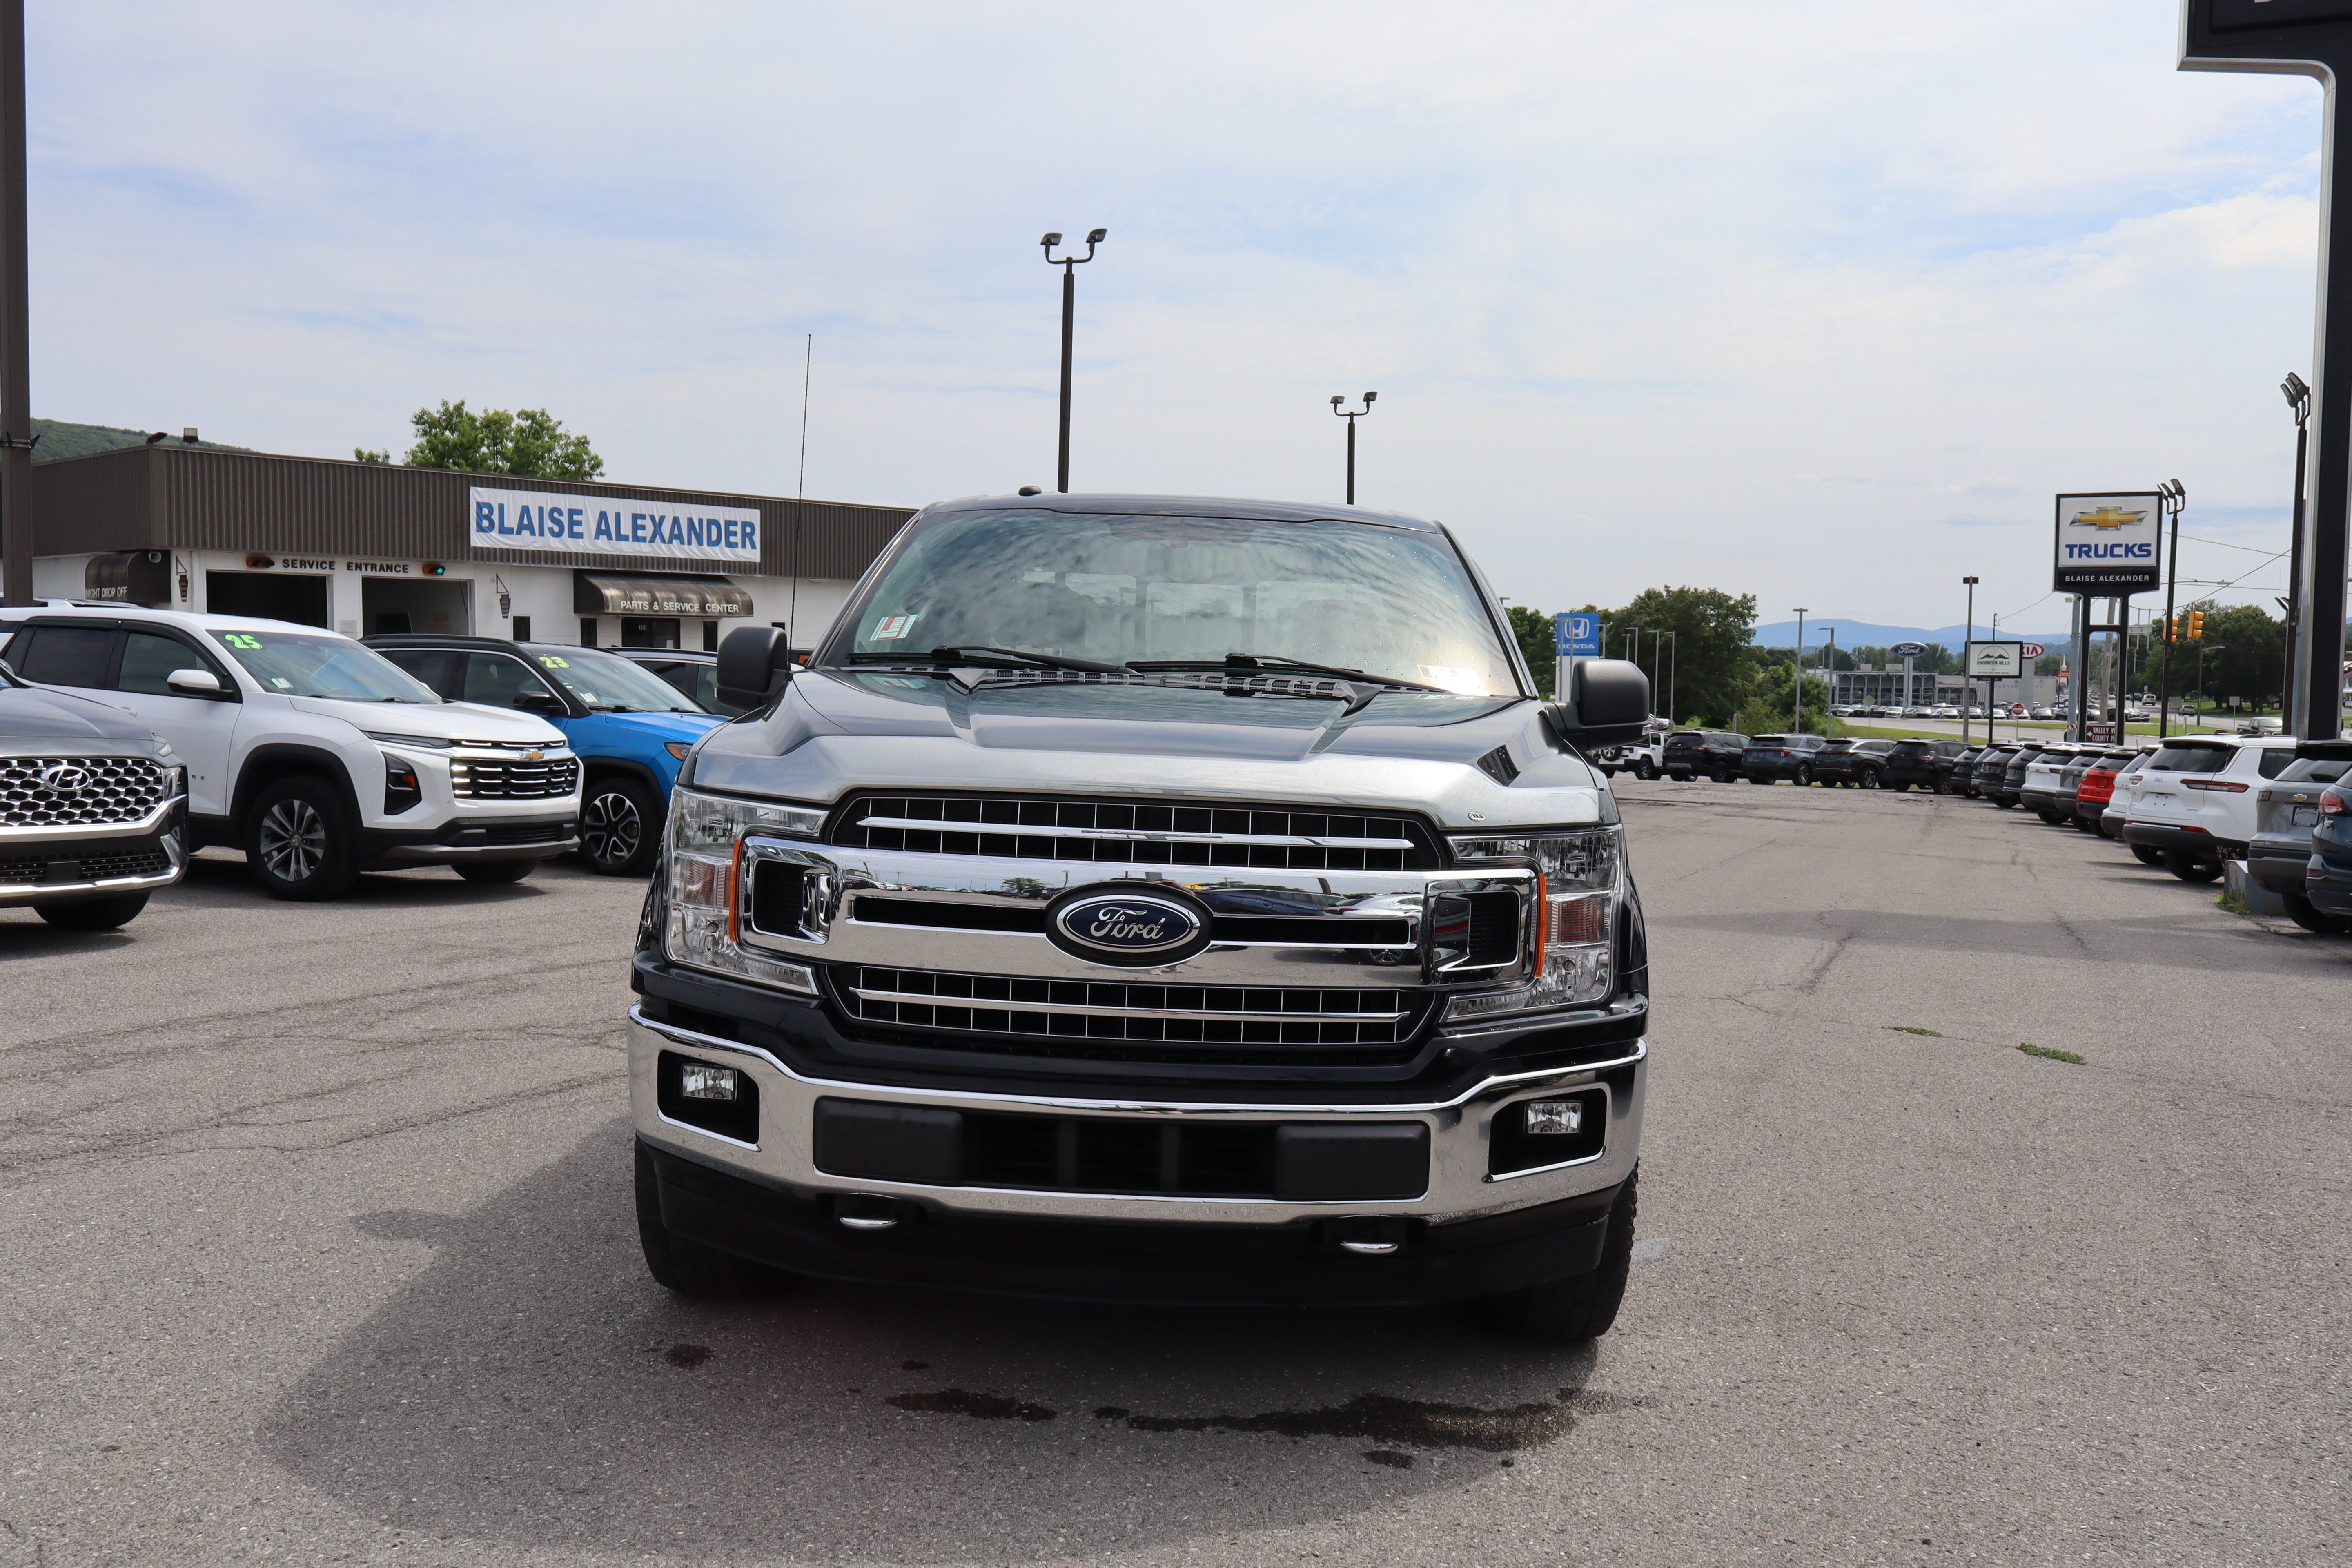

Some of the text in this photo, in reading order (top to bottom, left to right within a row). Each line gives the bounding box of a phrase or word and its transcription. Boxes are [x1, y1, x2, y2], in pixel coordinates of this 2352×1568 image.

[475, 501, 757, 550] BLAISE ALEXANDER
[2065, 543, 2152, 558] TRUCKS
[282, 559, 409, 573] SERVICE ENTRANCE
[85, 586, 127, 598] NIGHT DROP OFF
[621, 601, 739, 612] PARTS & SERVICE CENTER
[225, 634, 263, 650] 25
[1898, 645, 1920, 654] Ford
[538, 656, 569, 669] 23
[1090, 907, 1165, 940] Ford
